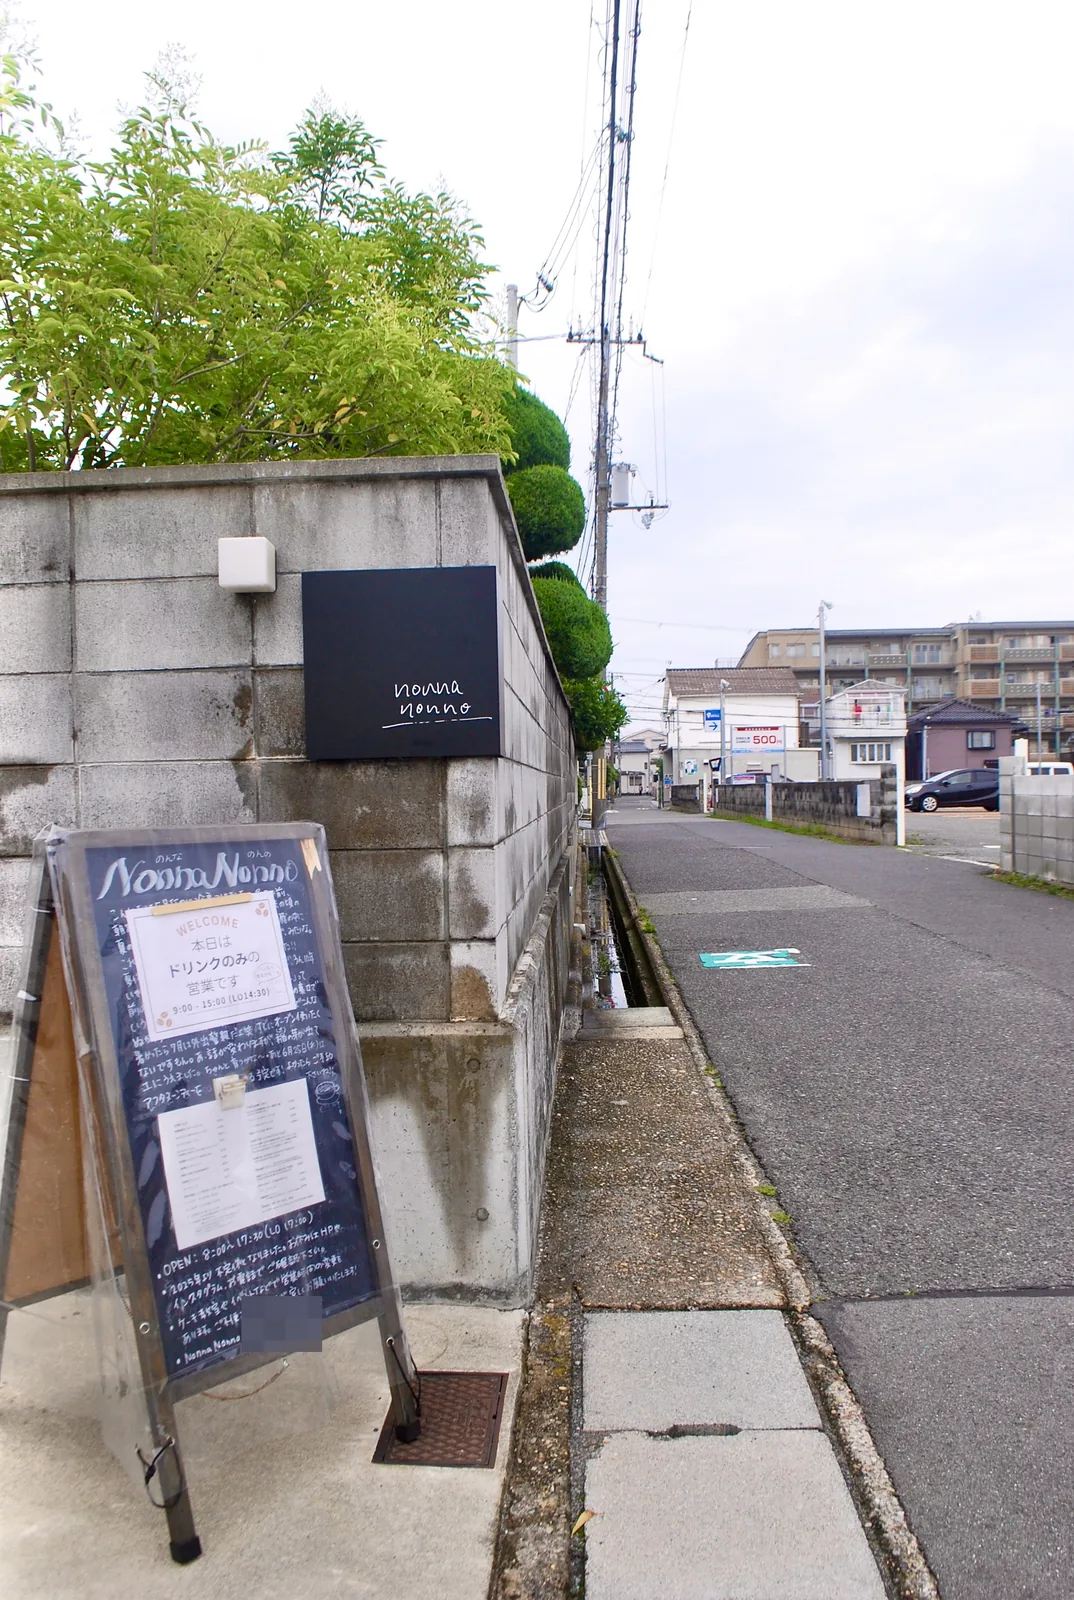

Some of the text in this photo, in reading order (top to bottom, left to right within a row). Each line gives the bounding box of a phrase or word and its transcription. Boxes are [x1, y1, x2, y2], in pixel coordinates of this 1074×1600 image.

[97, 856, 207, 900] Nonna
[176, 915, 239, 937] WELCOME
[190, 936, 232, 952] 本日は
[169, 951, 260, 978] ドリンクのみの
[186, 974, 240, 996] 営業です
[172, 1003, 193, 1015] 9:00
[202, 997, 226, 1009] 15:00
